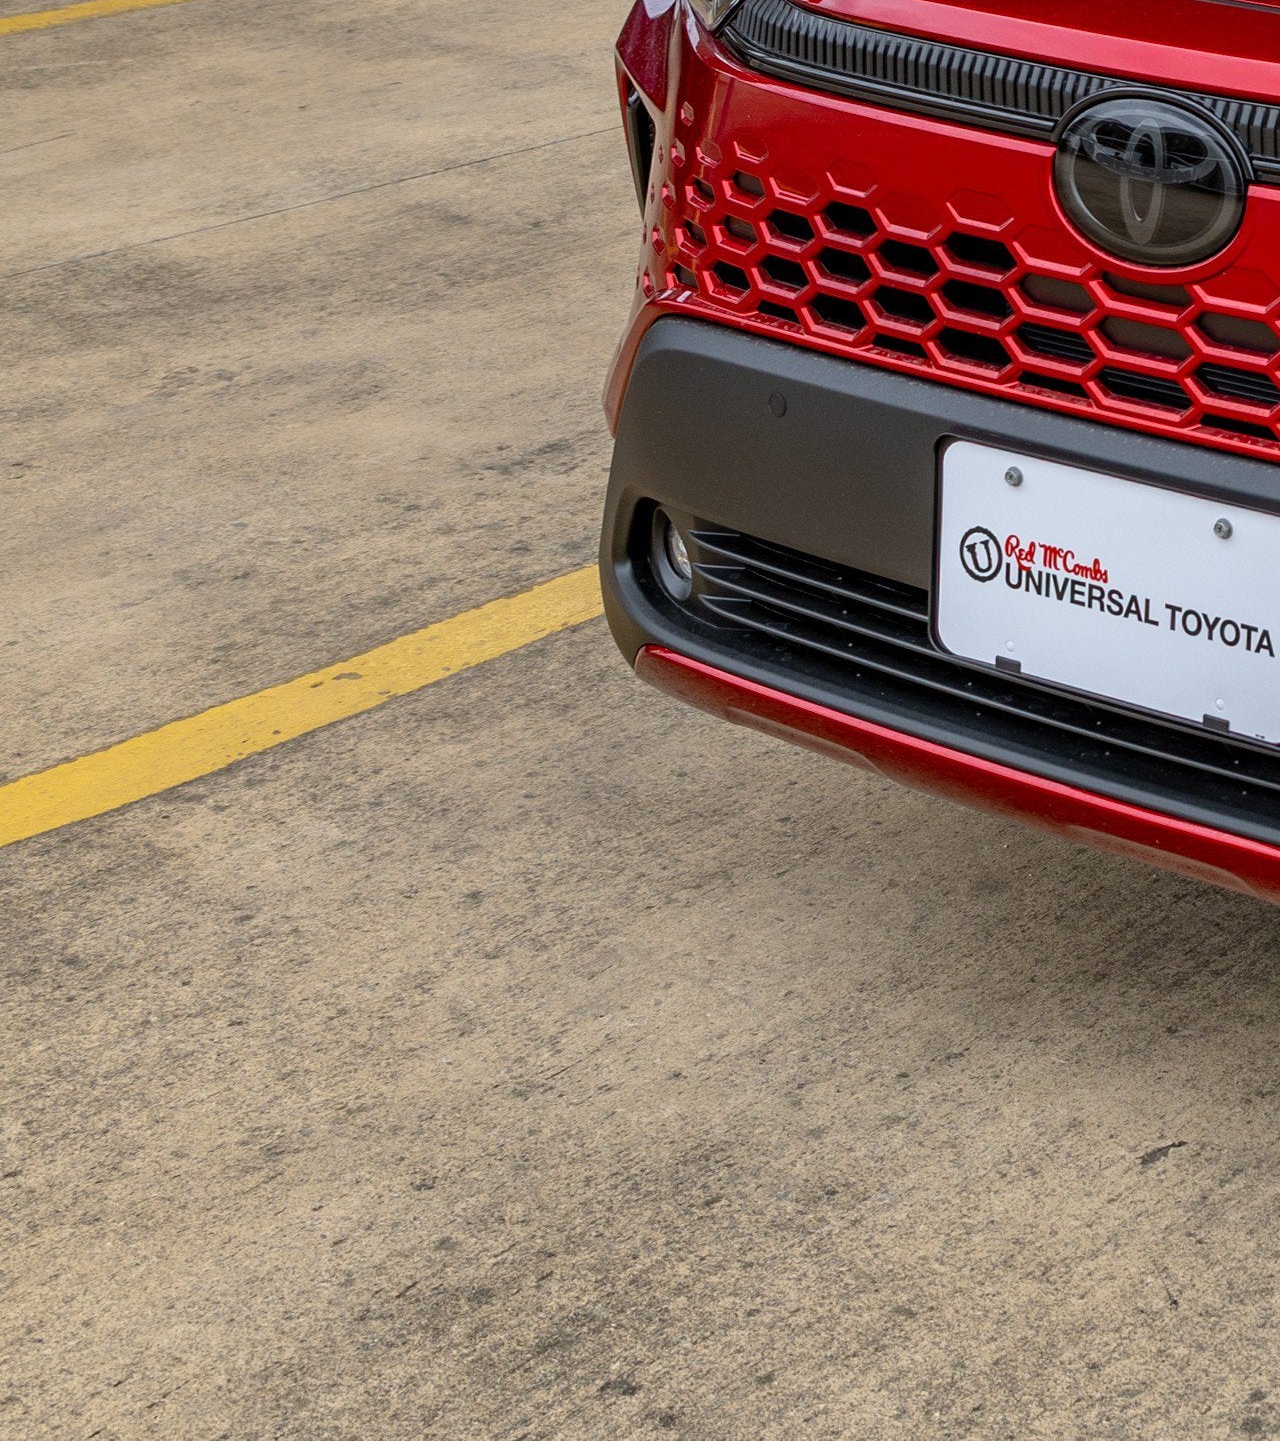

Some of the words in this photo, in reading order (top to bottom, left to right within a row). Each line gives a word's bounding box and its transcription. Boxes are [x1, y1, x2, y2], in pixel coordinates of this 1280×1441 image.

[1004, 534, 1036, 571] Red
[1038, 542, 1109, 584] McCombs
[1005, 562, 1160, 627] UNIVERSAL
[1164, 603, 1276, 658] TOYOTA
